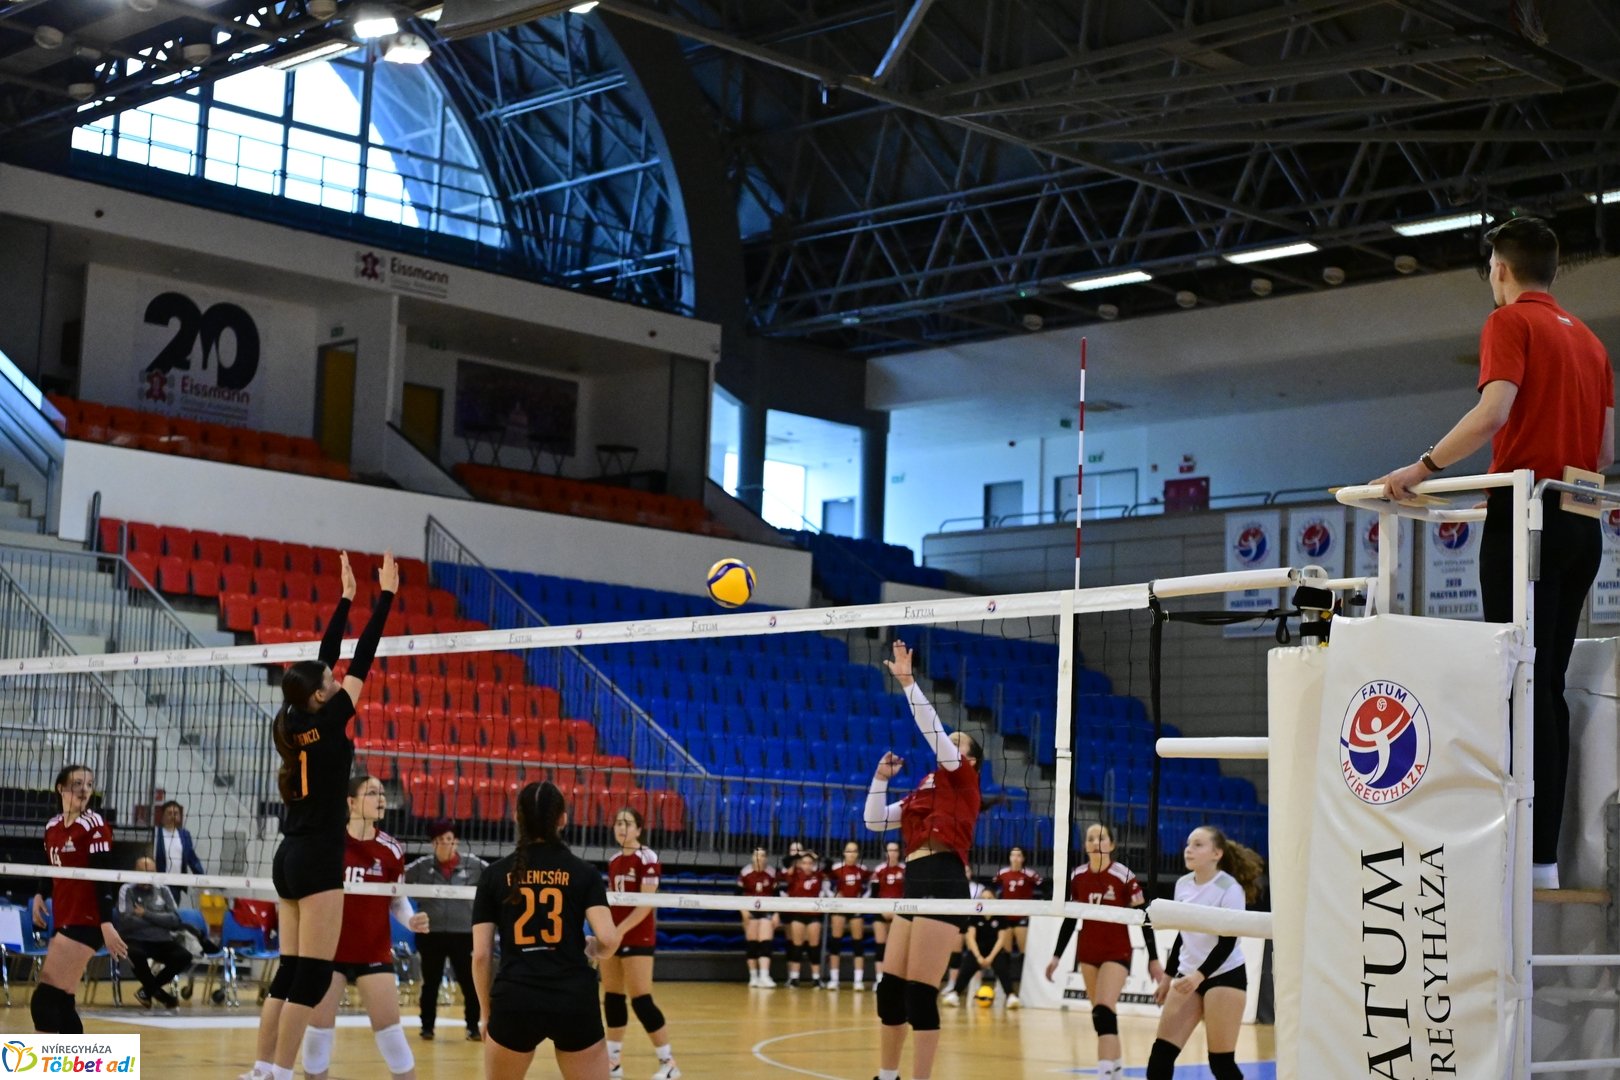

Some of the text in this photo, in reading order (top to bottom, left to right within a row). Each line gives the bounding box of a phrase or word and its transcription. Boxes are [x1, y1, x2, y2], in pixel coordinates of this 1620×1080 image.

[144, 291, 260, 391] 20
[1361, 683, 1408, 703] FATUM
[299, 750, 309, 797] 1
[514, 887, 563, 945] 23
[1360, 841, 1413, 1080] ATUM
[1414, 843, 1457, 1080] REGYHÁZA
